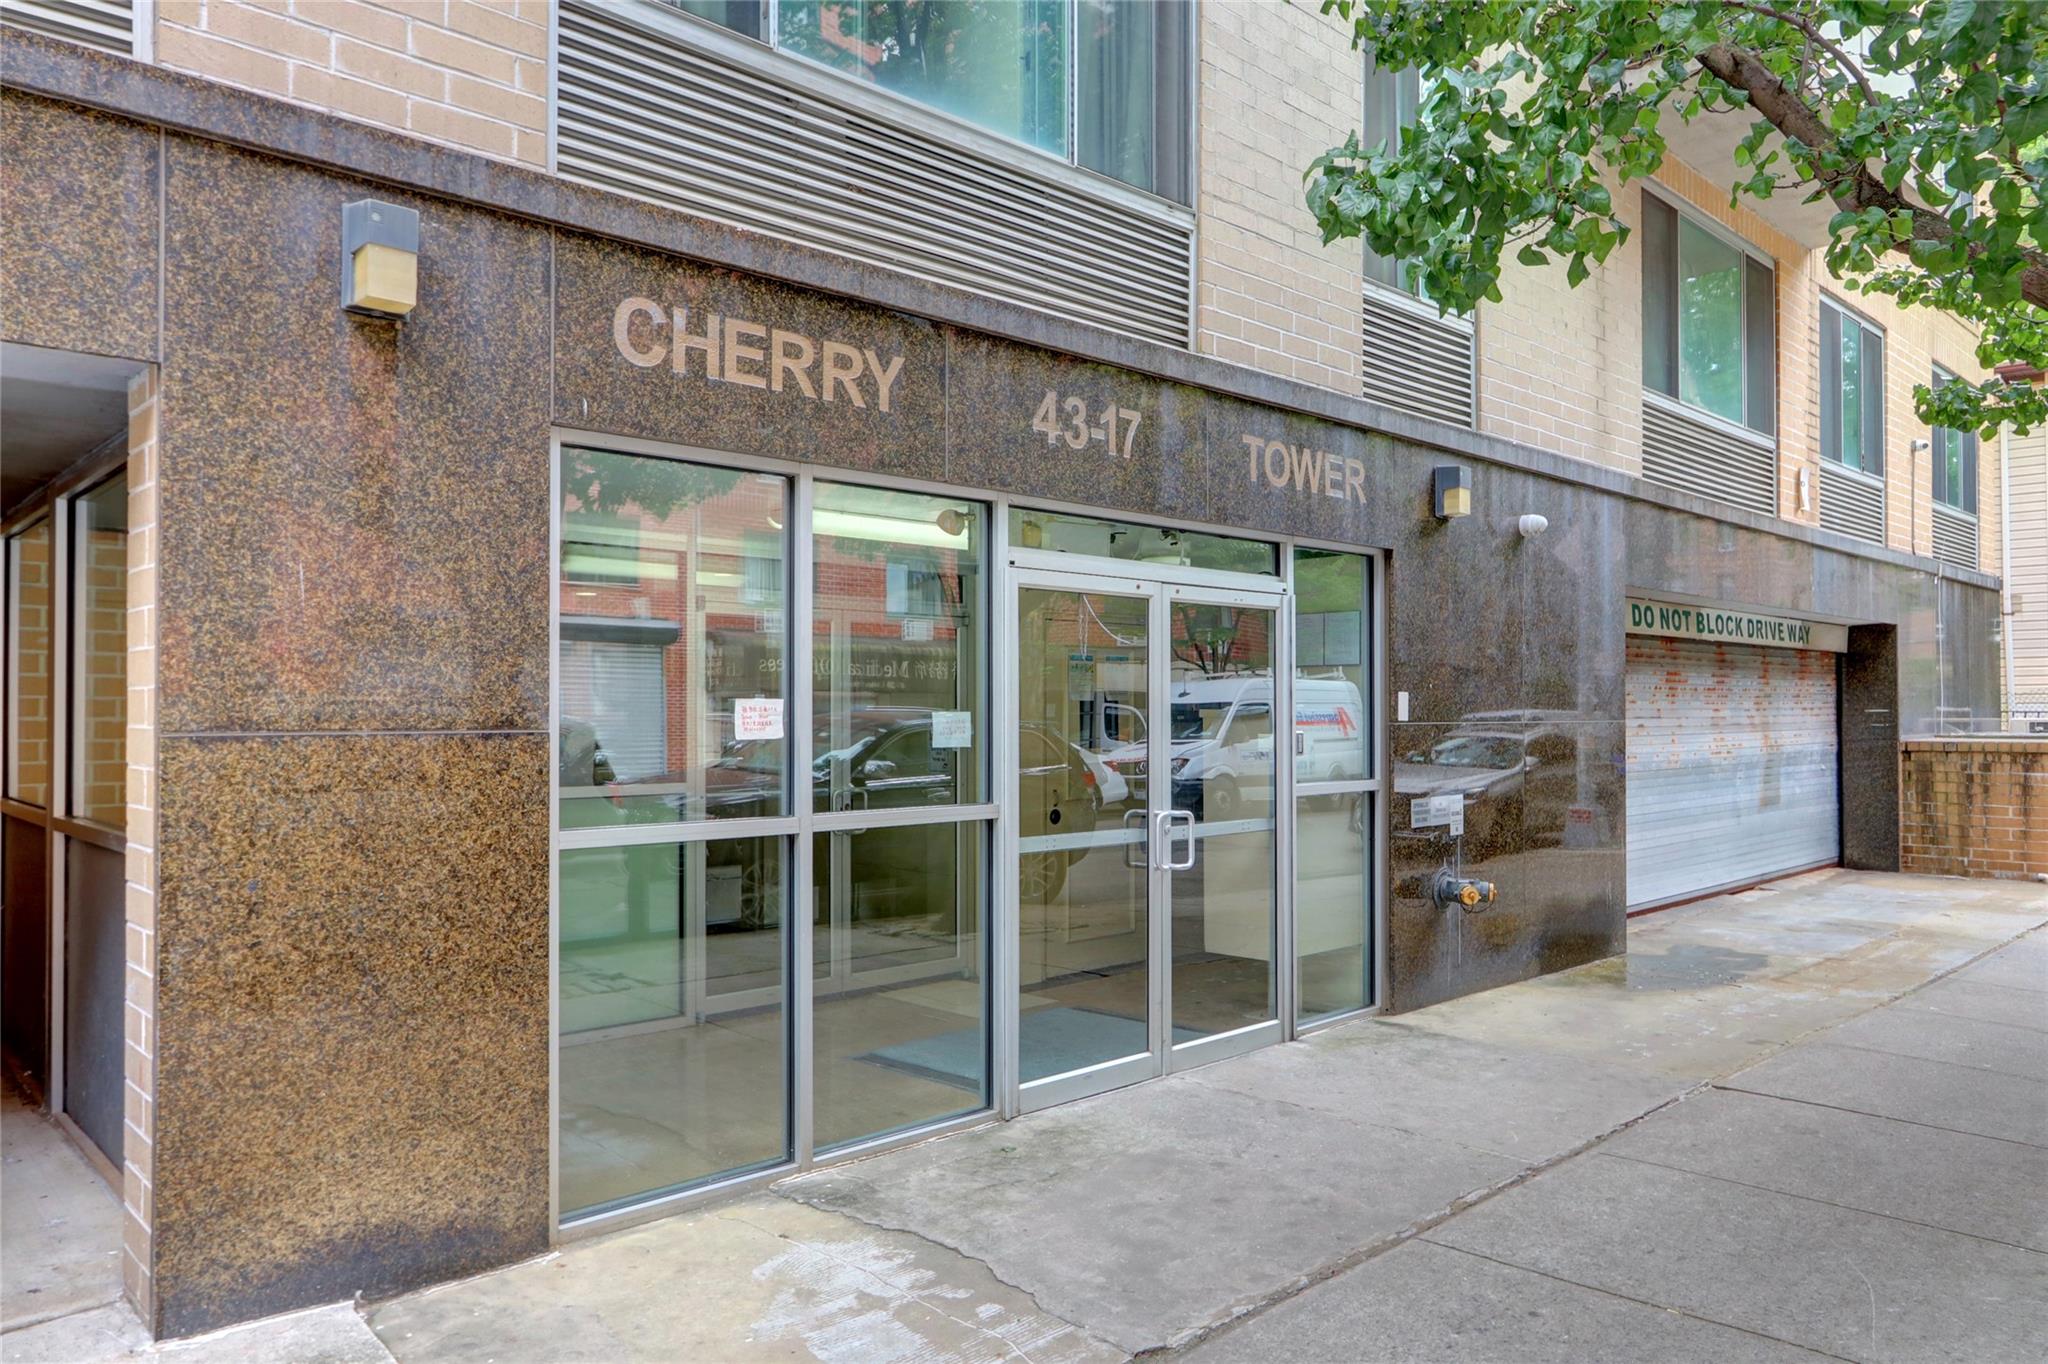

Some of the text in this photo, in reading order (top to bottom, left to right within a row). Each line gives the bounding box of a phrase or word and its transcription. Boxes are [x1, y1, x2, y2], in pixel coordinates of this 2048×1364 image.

[613, 296, 905, 414] CHERRY
[1032, 390, 1142, 459] 43-17
[1242, 434, 1367, 505] TOWER
[1632, 603, 1811, 645] DO NOT BLOCK DRIVE WAY
